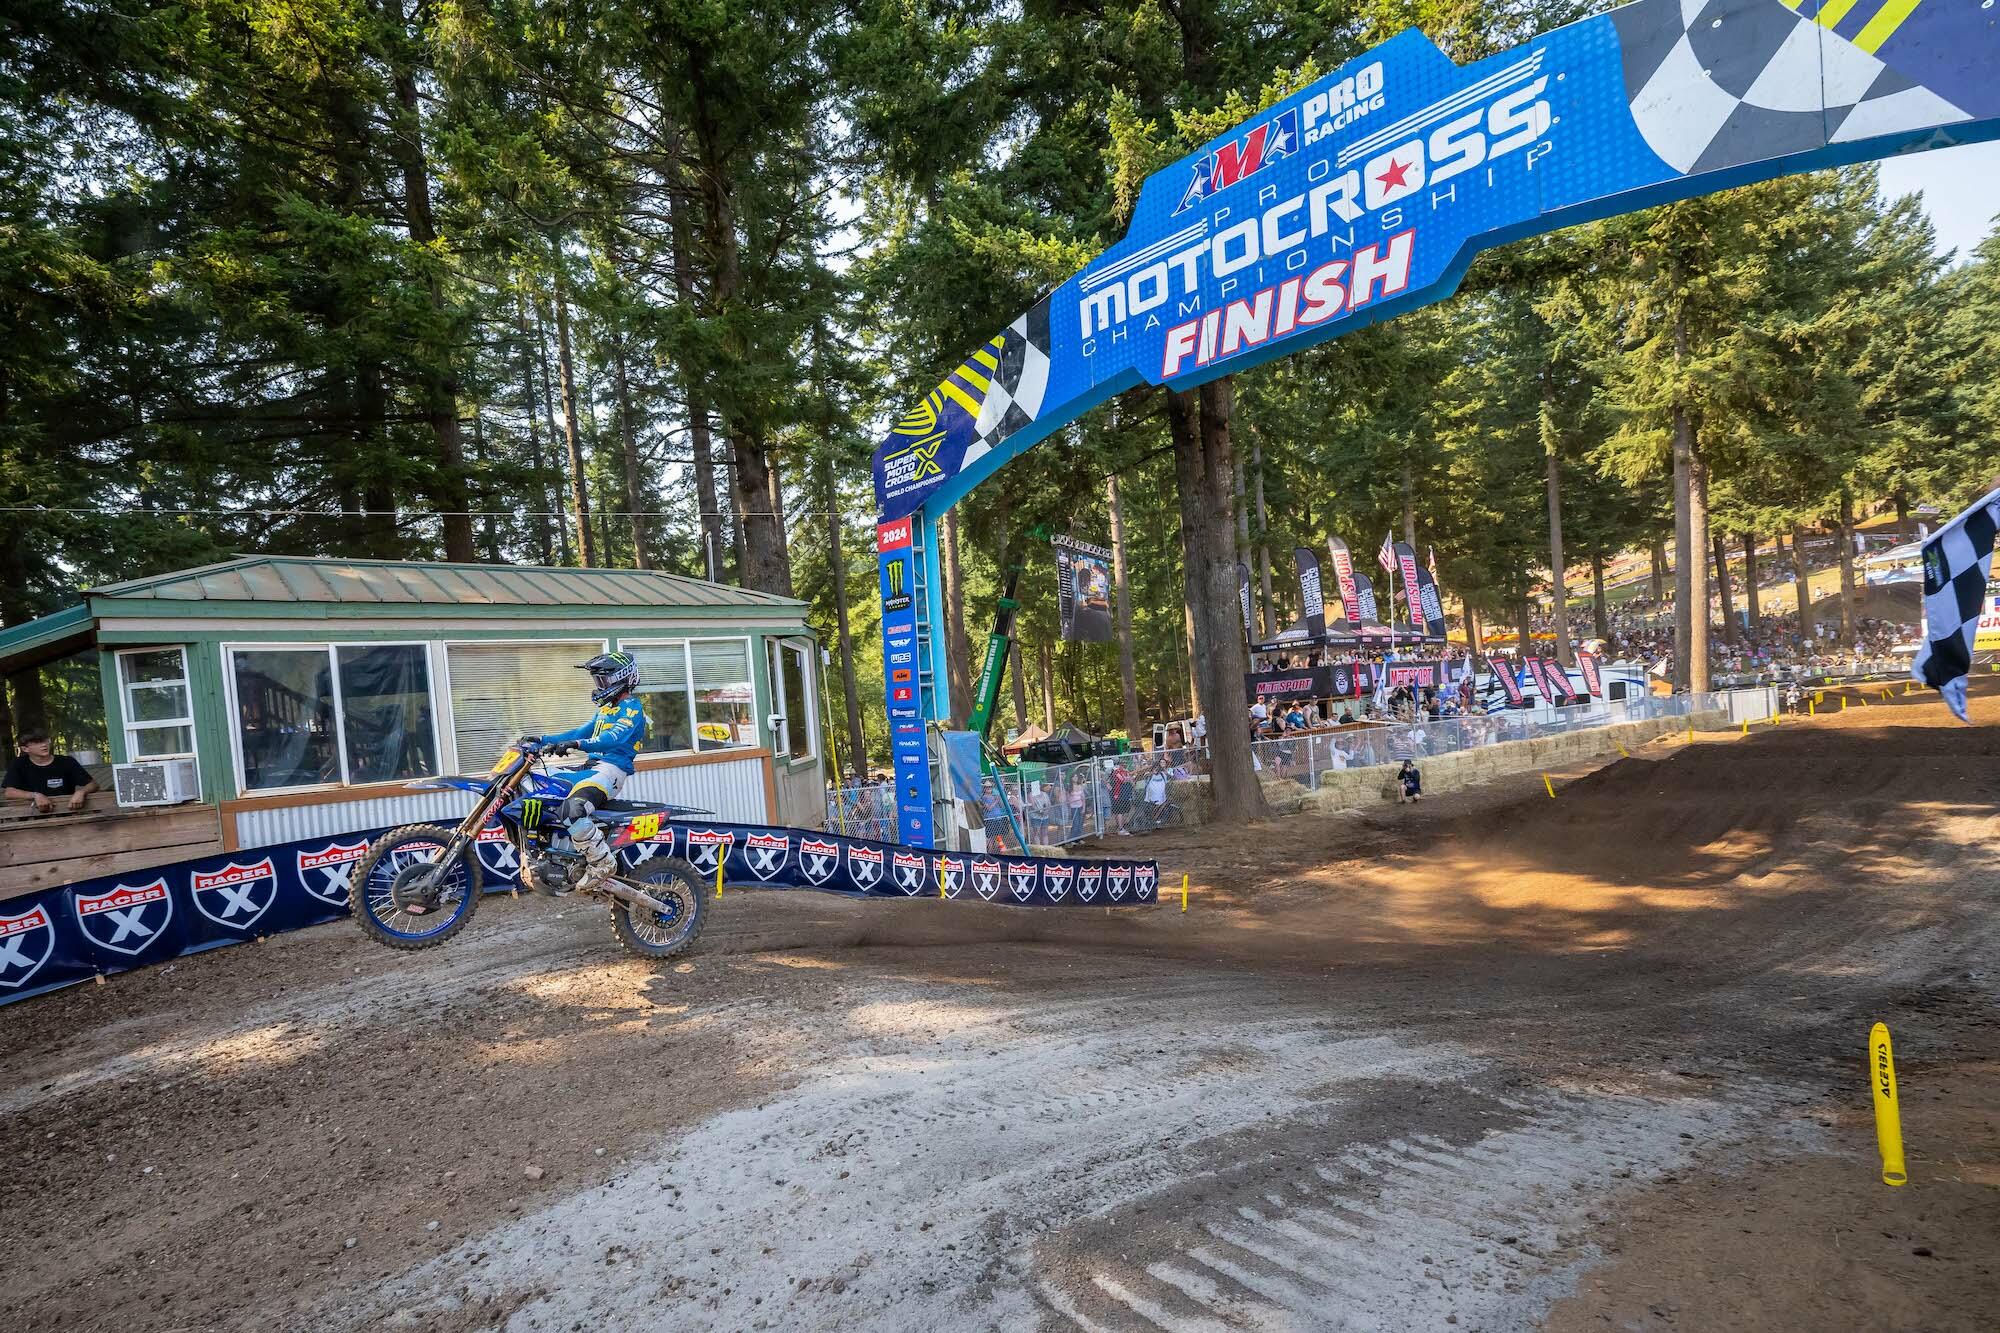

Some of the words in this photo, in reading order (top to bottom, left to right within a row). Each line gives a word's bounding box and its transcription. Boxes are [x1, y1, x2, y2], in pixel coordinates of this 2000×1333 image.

[1302, 61, 1384, 130] PRO
[1304, 92, 1385, 147] RACING
[1170, 106, 1299, 218] AMA
[1214, 159, 1329, 228] PRO
[1080, 75, 1551, 339] MOTOCROSS
[1082, 140, 1553, 358] CHAMPIONSHIP
[1161, 228, 1416, 378] FINISH
[884, 453, 918, 472] SUPER
[886, 462, 915, 479] MOTO
[885, 470, 916, 488] CROSS
[886, 488, 905, 499] WORLD
[905, 473, 946, 492] CHAMPIONSHIP
[882, 526, 908, 544] 2024
[480, 832, 506, 840] RAC
[629, 813, 660, 840] 38
[691, 835, 731, 843] RACER
[749, 839, 787, 848] RACER
[304, 849, 365, 867] RACER
[493, 843, 519, 868] X
[694, 845, 719, 865] X
[756, 849, 777, 871] X
[803, 845, 836, 855] RACER
[849, 851, 881, 861] RACER
[809, 855, 829, 876] X
[856, 861, 876, 882] X
[895, 858, 924, 867] RACER
[973, 865, 998, 873] RACER
[198, 867, 269, 888] RACER
[319, 862, 354, 896] X
[902, 867, 918, 888] X
[979, 874, 994, 892] X
[1016, 876, 1029, 893] X
[1051, 878, 1063, 894] X
[1082, 879, 1094, 894] X
[1112, 878, 1122, 893] X
[1139, 877, 1148, 893] X
[83, 889, 161, 912] RACER
[216, 883, 260, 918] X
[0, 917, 40, 935] CER
[104, 905, 154, 944] X
[1878, 1043, 1891, 1099] ACERBIS
